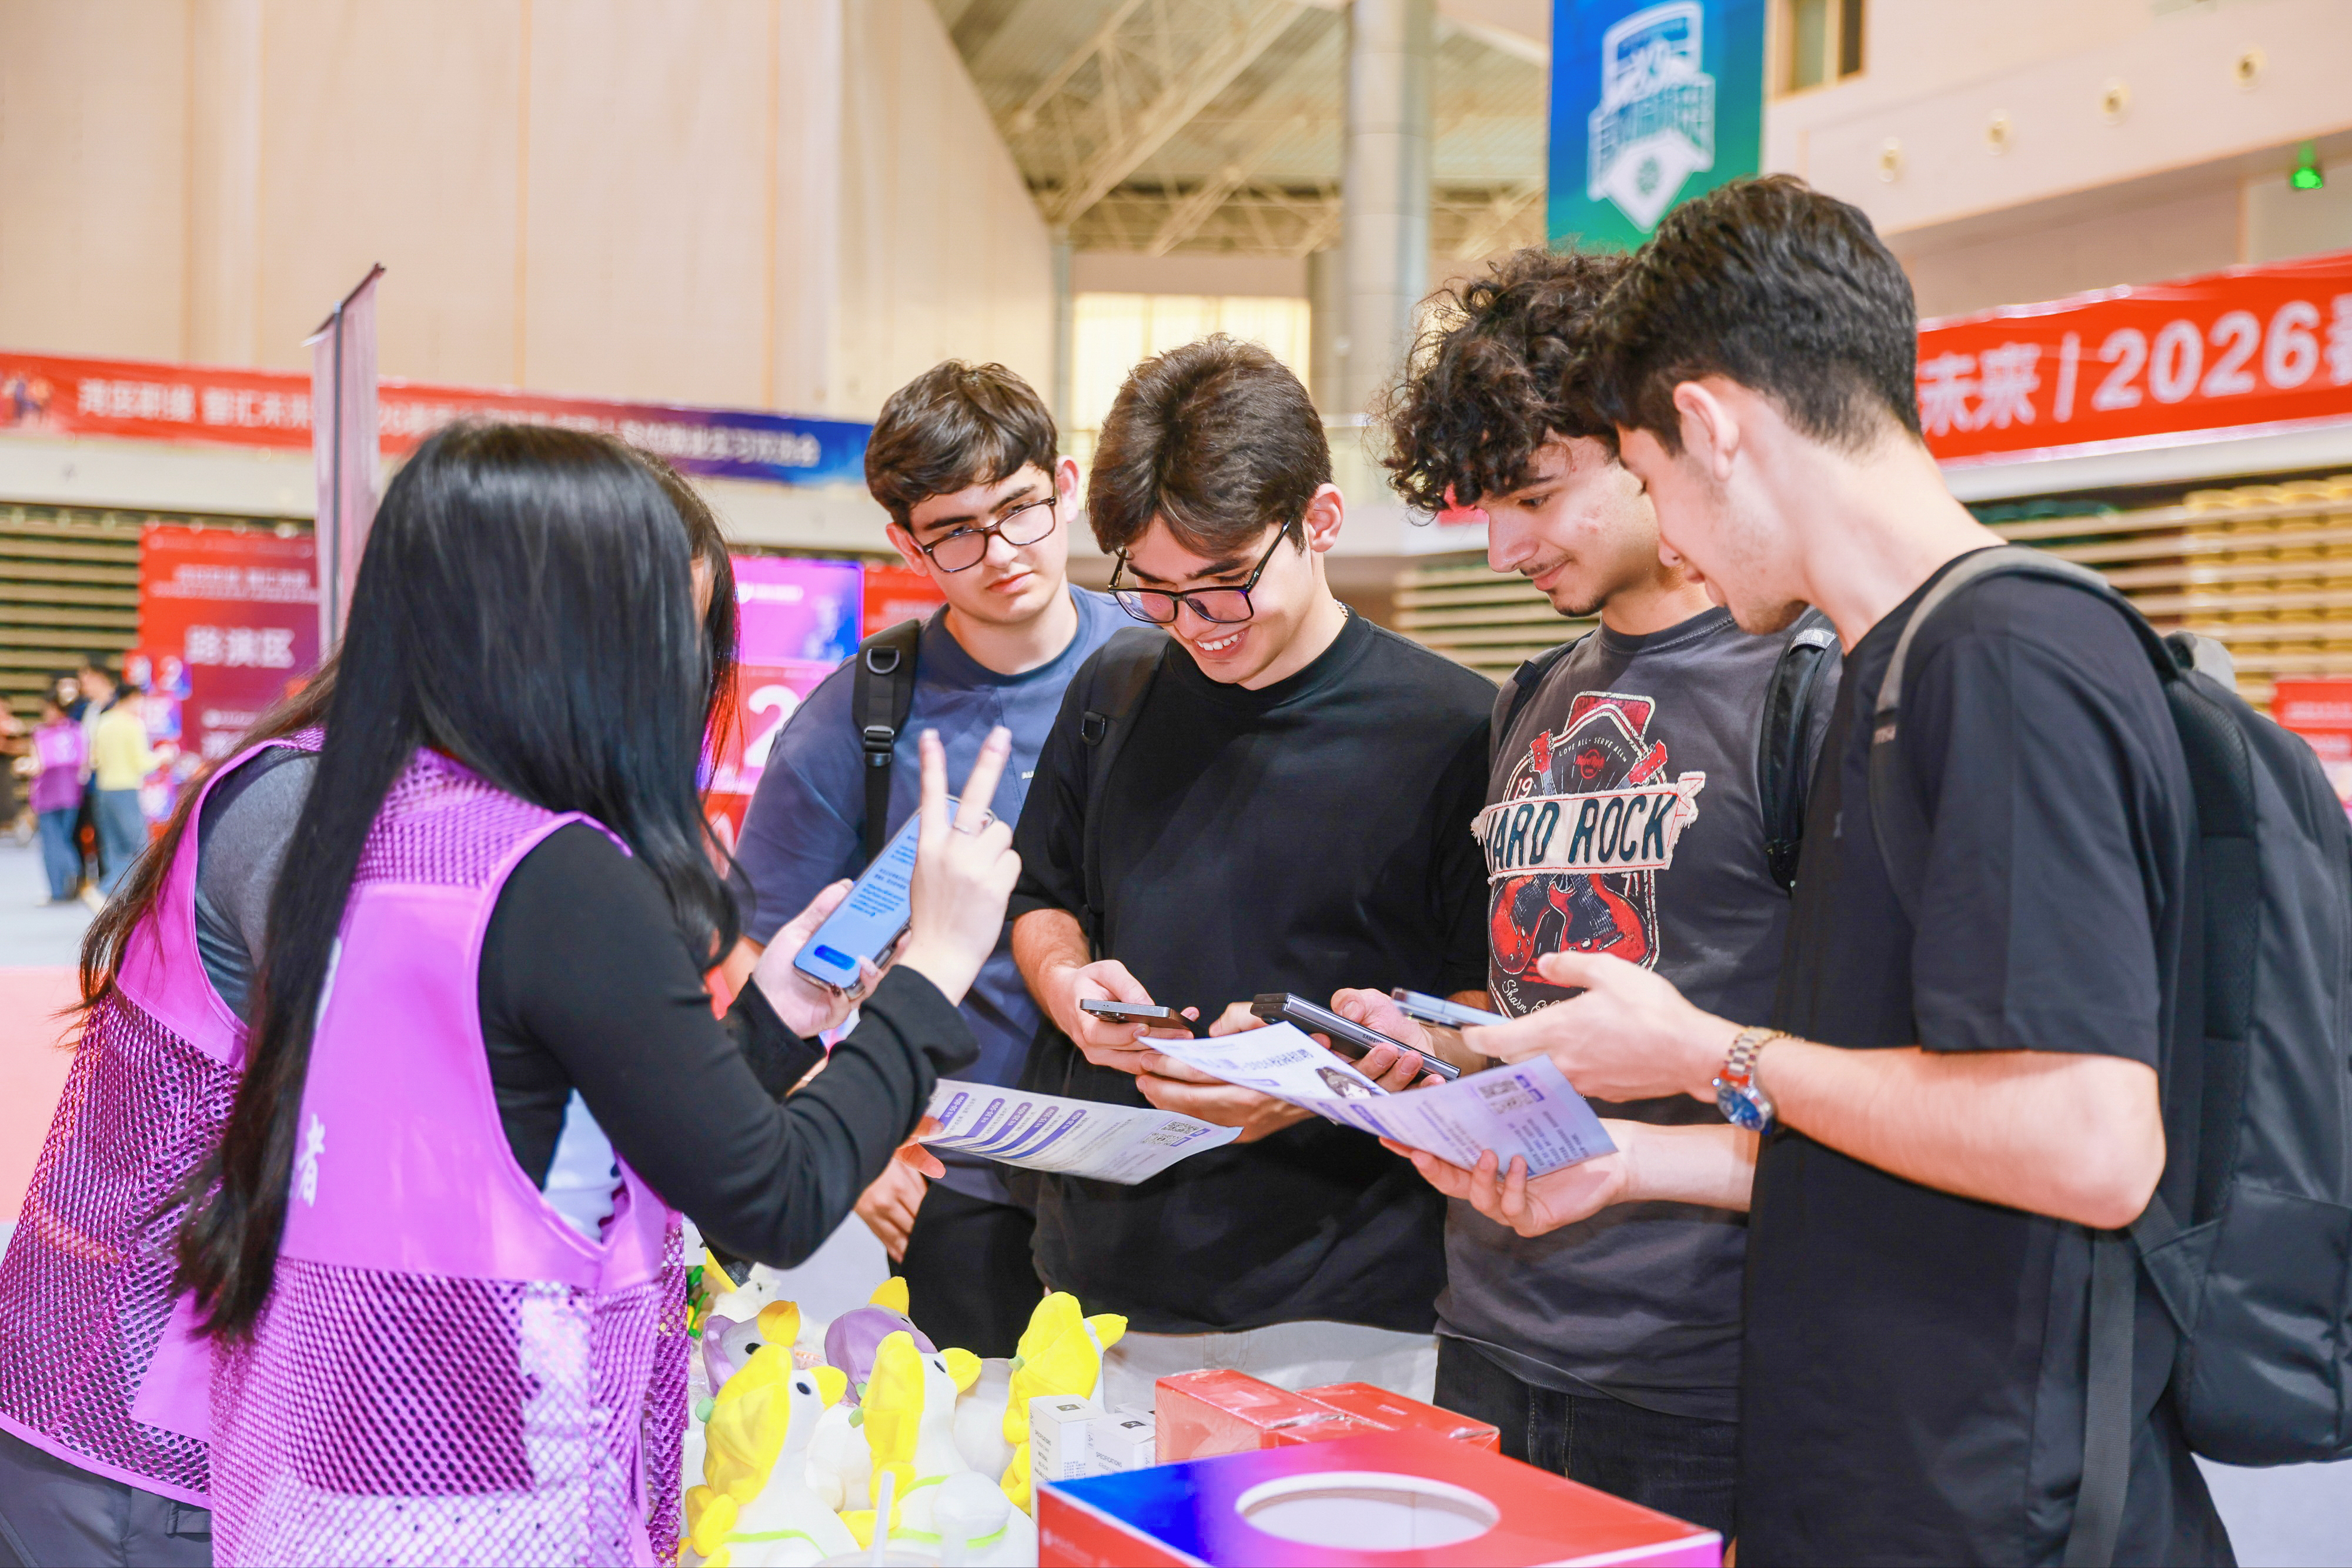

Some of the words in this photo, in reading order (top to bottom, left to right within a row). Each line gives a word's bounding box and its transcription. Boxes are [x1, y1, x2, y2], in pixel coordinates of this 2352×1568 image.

[1919, 341, 2042, 436] 未来
[1558, 743, 1575, 757] LOVE
[1593, 737, 1613, 748] SERVE
[1513, 775, 1534, 800] 19
[1568, 794, 1678, 864] ROCK
[1502, 979, 1528, 1014] Sharm
[1035, 1429, 1051, 1446] SPECIFICATIONS
[1088, 1434, 1094, 1442] 3+
[1038, 1450, 1048, 1463] MATERIAL
[1096, 1452, 1122, 1468] SPECIFICATIONS
[1034, 1466, 1045, 1479] AVAILABLE
